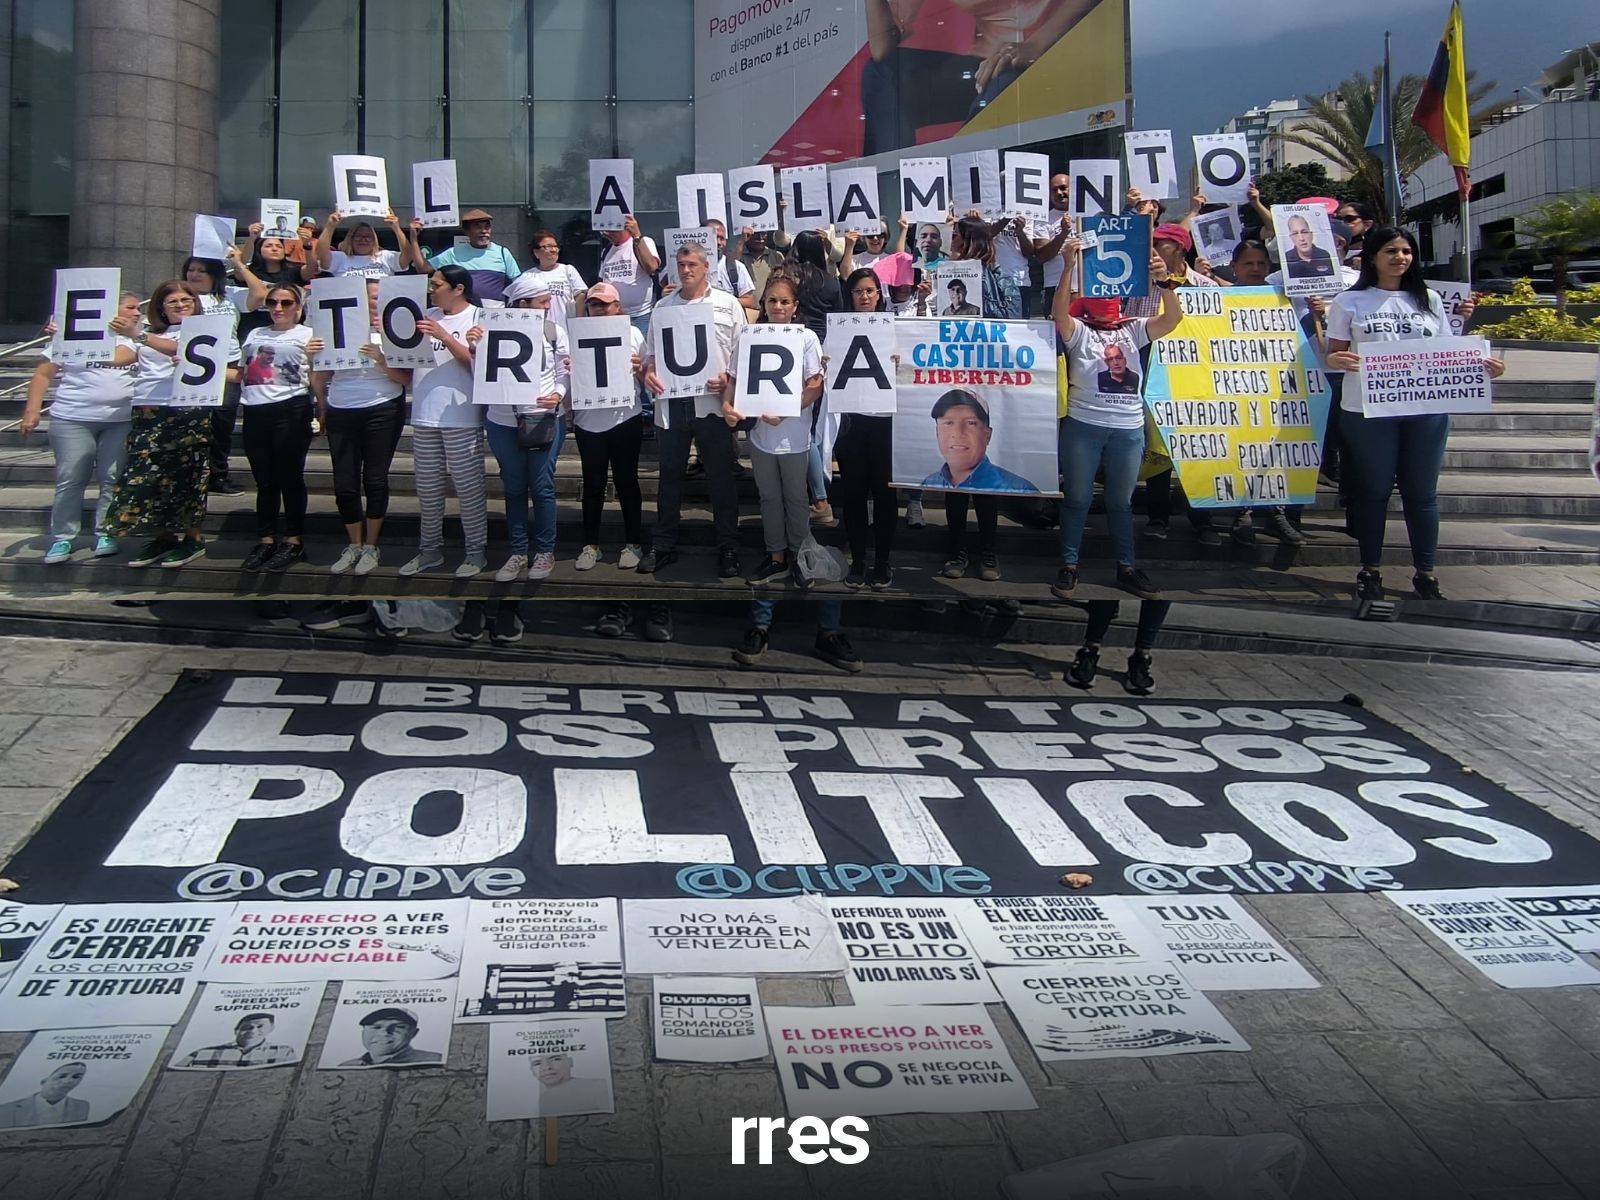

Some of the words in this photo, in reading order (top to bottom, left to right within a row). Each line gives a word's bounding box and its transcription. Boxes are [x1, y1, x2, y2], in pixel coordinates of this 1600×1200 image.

[730, 23, 783, 54] disponible
[785, 8, 811, 31] 24/7
[710, 69, 727, 82] con
[729, 63, 738, 75] el
[740, 51, 772, 72] Banco
[775, 41, 790, 58] #1
[793, 33, 810, 51] del
[813, 22, 839, 46] país
[1097, 218, 1134, 232] ART.
[1096, 233, 1133, 285] 5
[1091, 282, 1133, 295] CRBV
[1229, 308, 1297, 332] PROCESO
[1364, 312, 1401, 321] LIBEREN
[939, 320, 1007, 343] EXAR
[1364, 320, 1412, 335] JESÚS
[912, 343, 1035, 369] CASTILLO
[1157, 340, 1200, 363] PARA
[1210, 338, 1296, 363] MIGRANTES
[1365, 353, 1417, 363] EXIGIMOS
[1419, 352, 1430, 360] EL
[1432, 349, 1481, 359] DERECHO
[1425, 358, 1483, 368] CONTACTAR
[1427, 365, 1484, 375] FAMILIARES
[912, 369, 1032, 387] LIBERTAD
[1213, 370, 1269, 394] PRESOS
[1279, 370, 1298, 394] EN
[1307, 370, 1324, 394] EL
[1367, 374, 1485, 390] ENCARCELADOS
[1368, 387, 1485, 404] ILEGÍTIMAMENTE
[1154, 401, 1240, 426] SALVADOR
[1248, 400, 1259, 426] Y
[1270, 401, 1309, 425] PARA
[1169, 433, 1228, 459] PRESOS
[1238, 437, 1320, 468] POLÍTICOS
[1215, 476, 1235, 501] EN
[1245, 474, 1287, 499] VZLA
[222, 677, 854, 720] LIBEREN
[898, 700, 974, 723] A
[984, 700, 1366, 732] TODOS
[189, 706, 654, 758] LOS
[709, 722, 1431, 774] PRESOS
[102, 763, 1552, 867] POLÍTICOS
[517, 900, 600, 908] Venezuela
[1407, 903, 1435, 916] ES
[1435, 901, 1508, 915] URGENTE
[1514, 900, 1559, 912] YO
[241, 914, 263, 923] EL
[270, 913, 377, 924] DERECHO
[383, 913, 398, 923] A
[406, 912, 445, 922] VER
[543, 908, 573, 916] hay
[680, 913, 716, 924] NO
[724, 911, 777, 924] MÁS
[831, 907, 904, 918] DEFENDER
[909, 907, 946, 918] DDHH
[983, 909, 1010, 923] EL
[1009, 907, 1109, 922] HELICOIDE
[1146, 905, 1232, 921] TUN
[64, 919, 99, 933] ES
[104, 917, 215, 933] URGENTE
[233, 926, 250, 936] A
[258, 925, 378, 936] NUESTROS
[385, 924, 449, 935] SERES
[481, 924, 515, 932] solo
[520, 924, 583, 932] Centros
[649, 926, 771, 938] TORTURA
[778, 926, 811, 937] EN
[836, 921, 875, 940] NO
[880, 921, 915, 939] ES
[918, 921, 958, 939] UN
[1161, 923, 1251, 940] TUN
[1428, 915, 1534, 934] CUMPLIR
[1537, 919, 1595, 934] LA
[493, 933, 554, 941] Tortura
[560, 933, 596, 941] para
[657, 937, 811, 950] VENEZUELA
[999, 932, 1093, 944] CENTROS
[1099, 931, 1127, 942] DE
[1455, 936, 1505, 948] CON
[1504, 934, 1549, 946] LAS
[47, 934, 206, 960] CERRAR
[228, 939, 351, 951] QUERIDOS
[358, 939, 384, 949] ES
[846, 943, 968, 959] DELITO
[1006, 943, 1138, 959] TORTURA
[1166, 943, 1186, 951] ES
[220, 952, 408, 964] IRRENUNCIABLE
[1176, 950, 1288, 964] POLÍTICA
[35, 963, 82, 973] LOS
[87, 961, 195, 973] CENTROS
[852, 966, 955, 982] VIOLARLOS
[962, 962, 981, 981] SÍ
[18, 979, 61, 997] DE
[64, 978, 185, 997] TORTURA
[1023, 976, 1131, 990] CIERREN
[1133, 973, 1181, 986] LOS
[661, 995, 747, 1004] OLVIDADOS
[1035, 989, 1151, 1005] CENTROS
[1155, 988, 1191, 1000] DE
[660, 1006, 695, 1019] EN
[704, 1006, 754, 1020] LOS
[1061, 1003, 1187, 1020] TORTURA
[661, 1019, 755, 1028] COMANDOS
[662, 1028, 756, 1037] POLICIALES
[782, 1029, 806, 1041] EL
[811, 1026, 917, 1040] DERECHO
[924, 1025, 940, 1037] A
[943, 1024, 985, 1037] VER
[507, 1044, 587, 1056] RODRÍGUEZ
[528, 1039, 565, 1047] JUAN
[786, 1045, 799, 1054] A
[804, 1044, 835, 1054] LOS
[840, 1042, 904, 1053] PRESOS
[909, 1039, 994, 1051] POLÍTICOS
[46, 1052, 133, 1060] SIFUENTES
[897, 1063, 919, 1073] SE
[922, 1060, 1004, 1072] NEGOCIA
[791, 1060, 893, 1090] NO
[903, 1075, 926, 1086] NI
[931, 1074, 956, 1085] SE
[959, 1072, 1014, 1084] PRIVA
